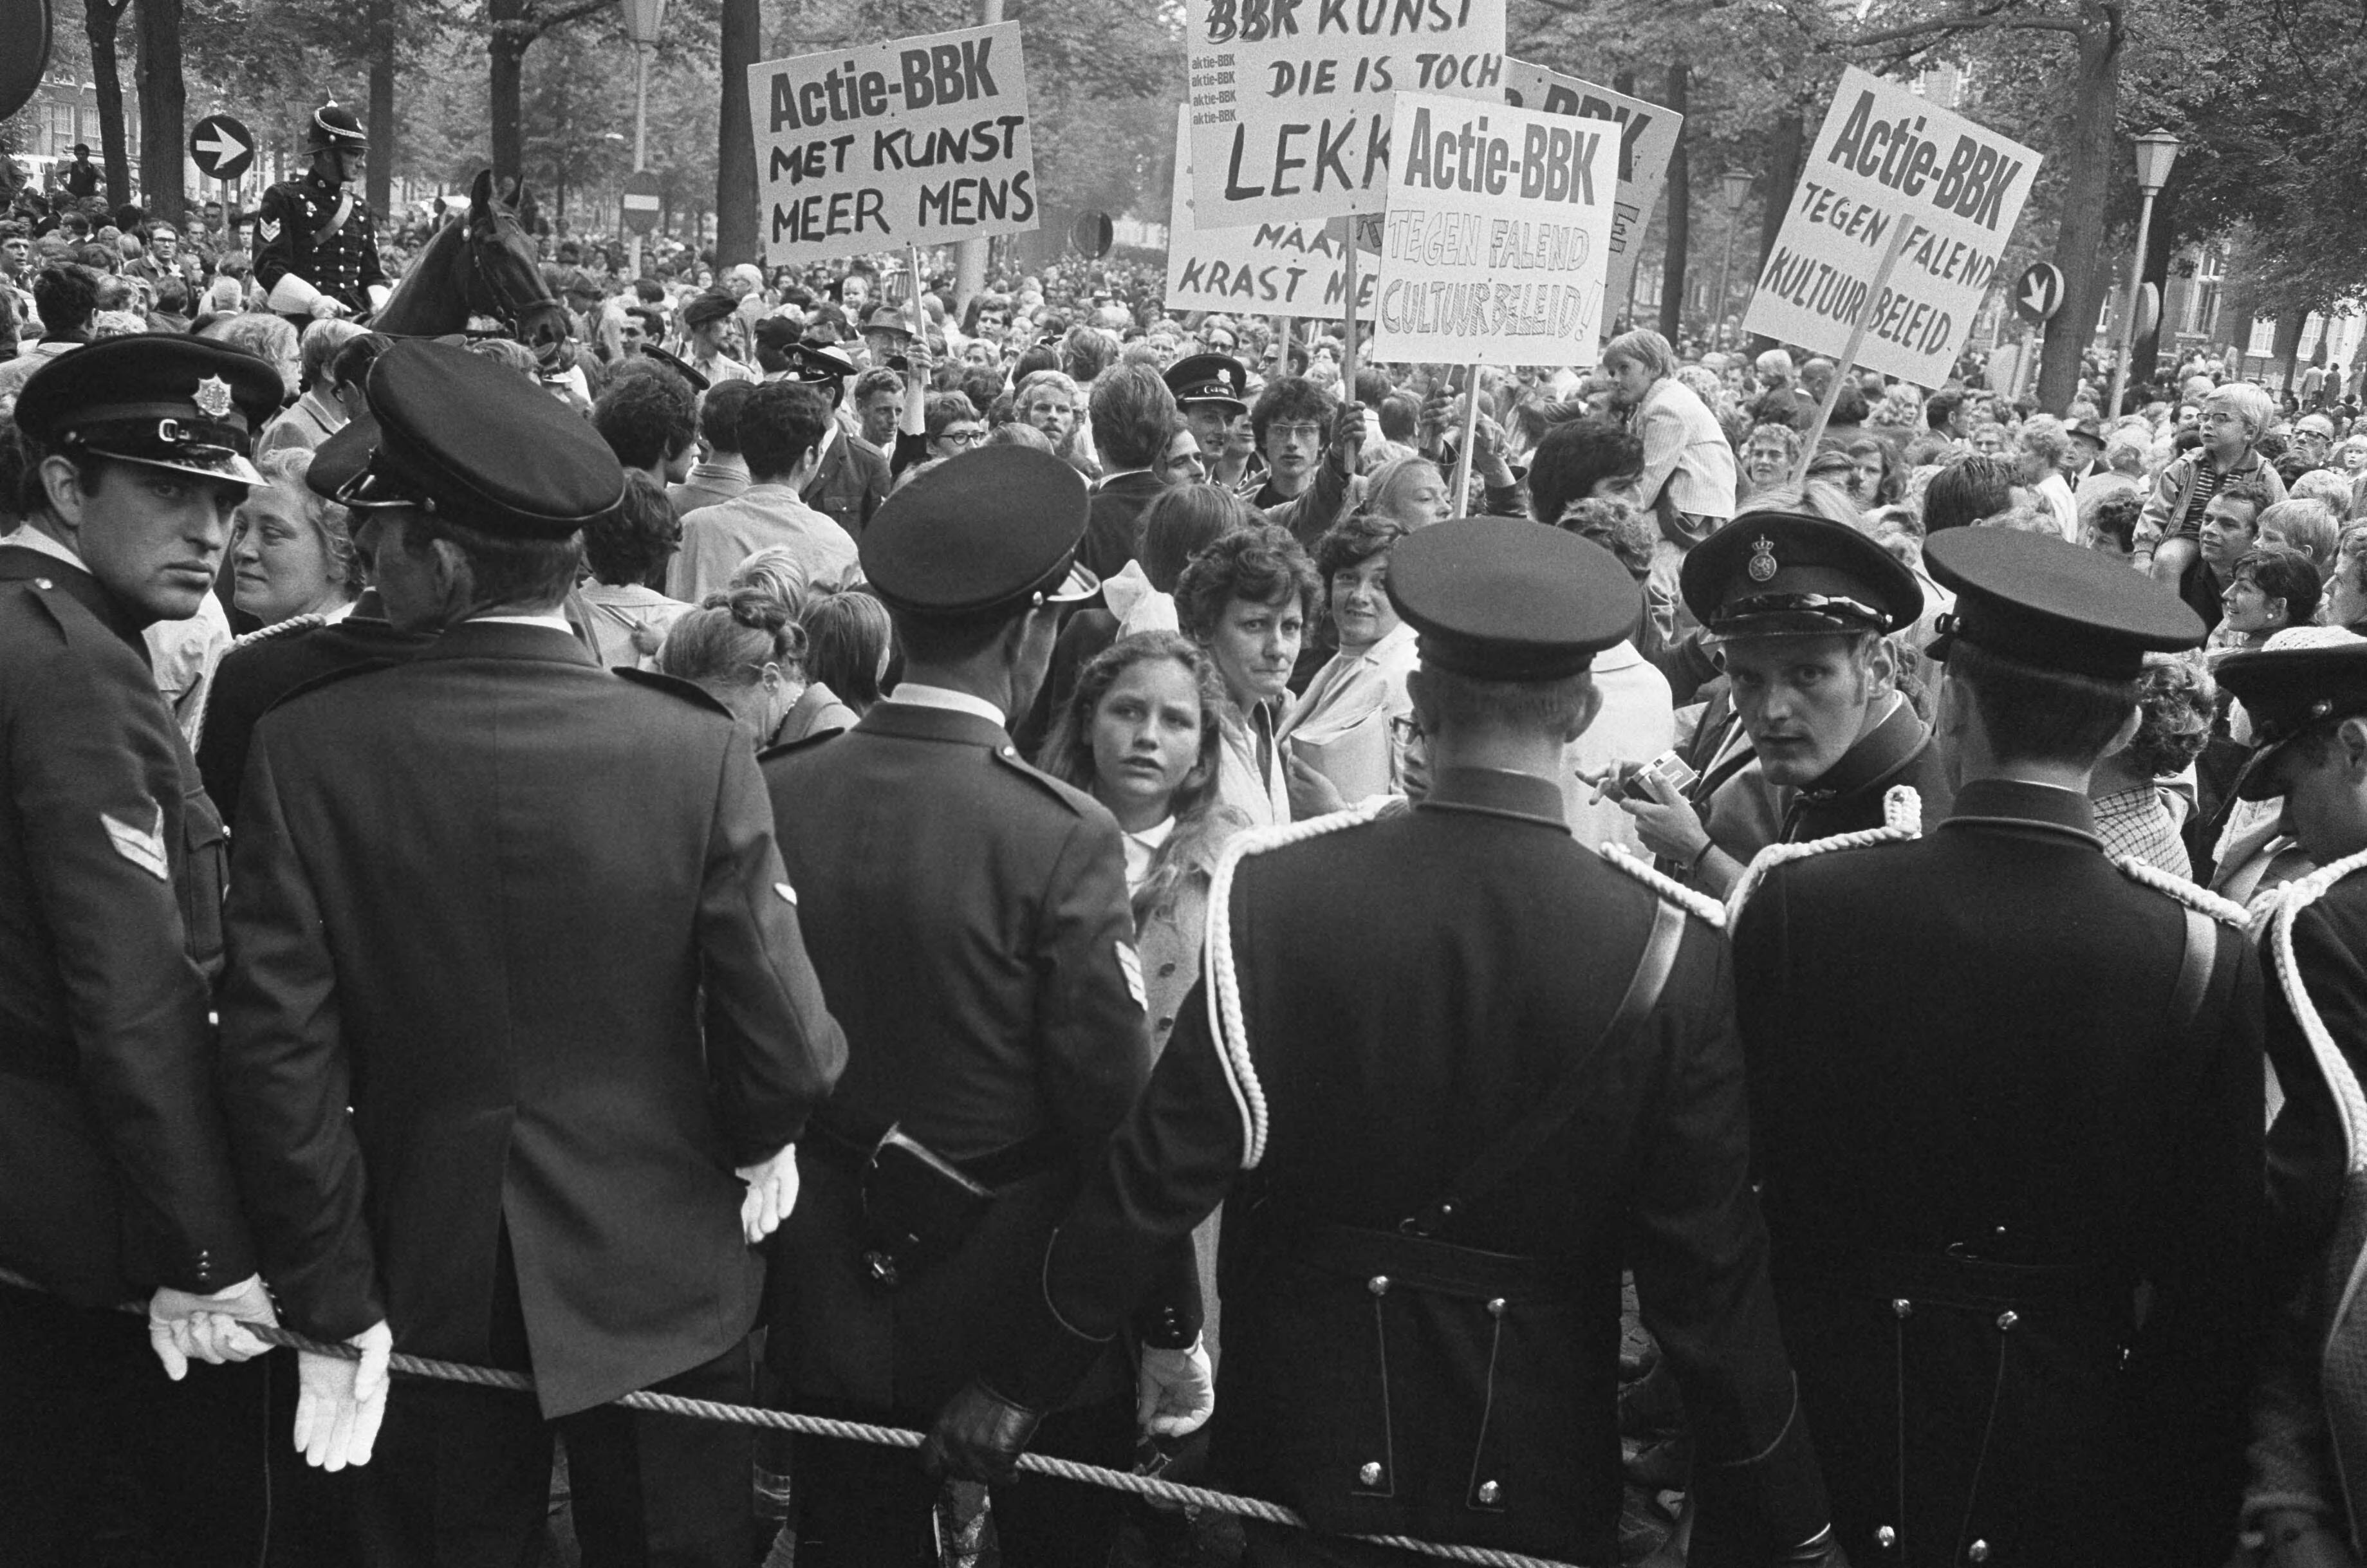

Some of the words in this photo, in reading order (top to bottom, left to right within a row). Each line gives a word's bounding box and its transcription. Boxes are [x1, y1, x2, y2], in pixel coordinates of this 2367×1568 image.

[770, 36, 999, 133] Actie-BBK
[1191, 53, 1235, 69] aktie-BBK
[1191, 71, 1235, 87] aktie-BBK
[1266, 59, 1338, 97] DIE
[1353, 56, 1393, 93] IS
[1416, 53, 1502, 89] TOCH
[1193, 89, 1236, 106] aktie-BBK
[1193, 109, 1236, 125] aktie-BBK
[770, 134, 855, 185] MET
[873, 115, 1025, 171] KUNST
[1404, 106, 1601, 206] Actie-BBK
[1827, 89, 2023, 232] Actie-BBK
[772, 188, 891, 243] MEER
[918, 170, 1035, 227] MENS
[1252, 223, 1344, 261] MAA
[1388, 209, 1481, 266] TEGEN
[1489, 219, 1590, 272] FALEND
[1801, 181, 1890, 247] TEGEN
[1899, 225, 1996, 290] FALEND
[1177, 257, 1308, 302] KRAST
